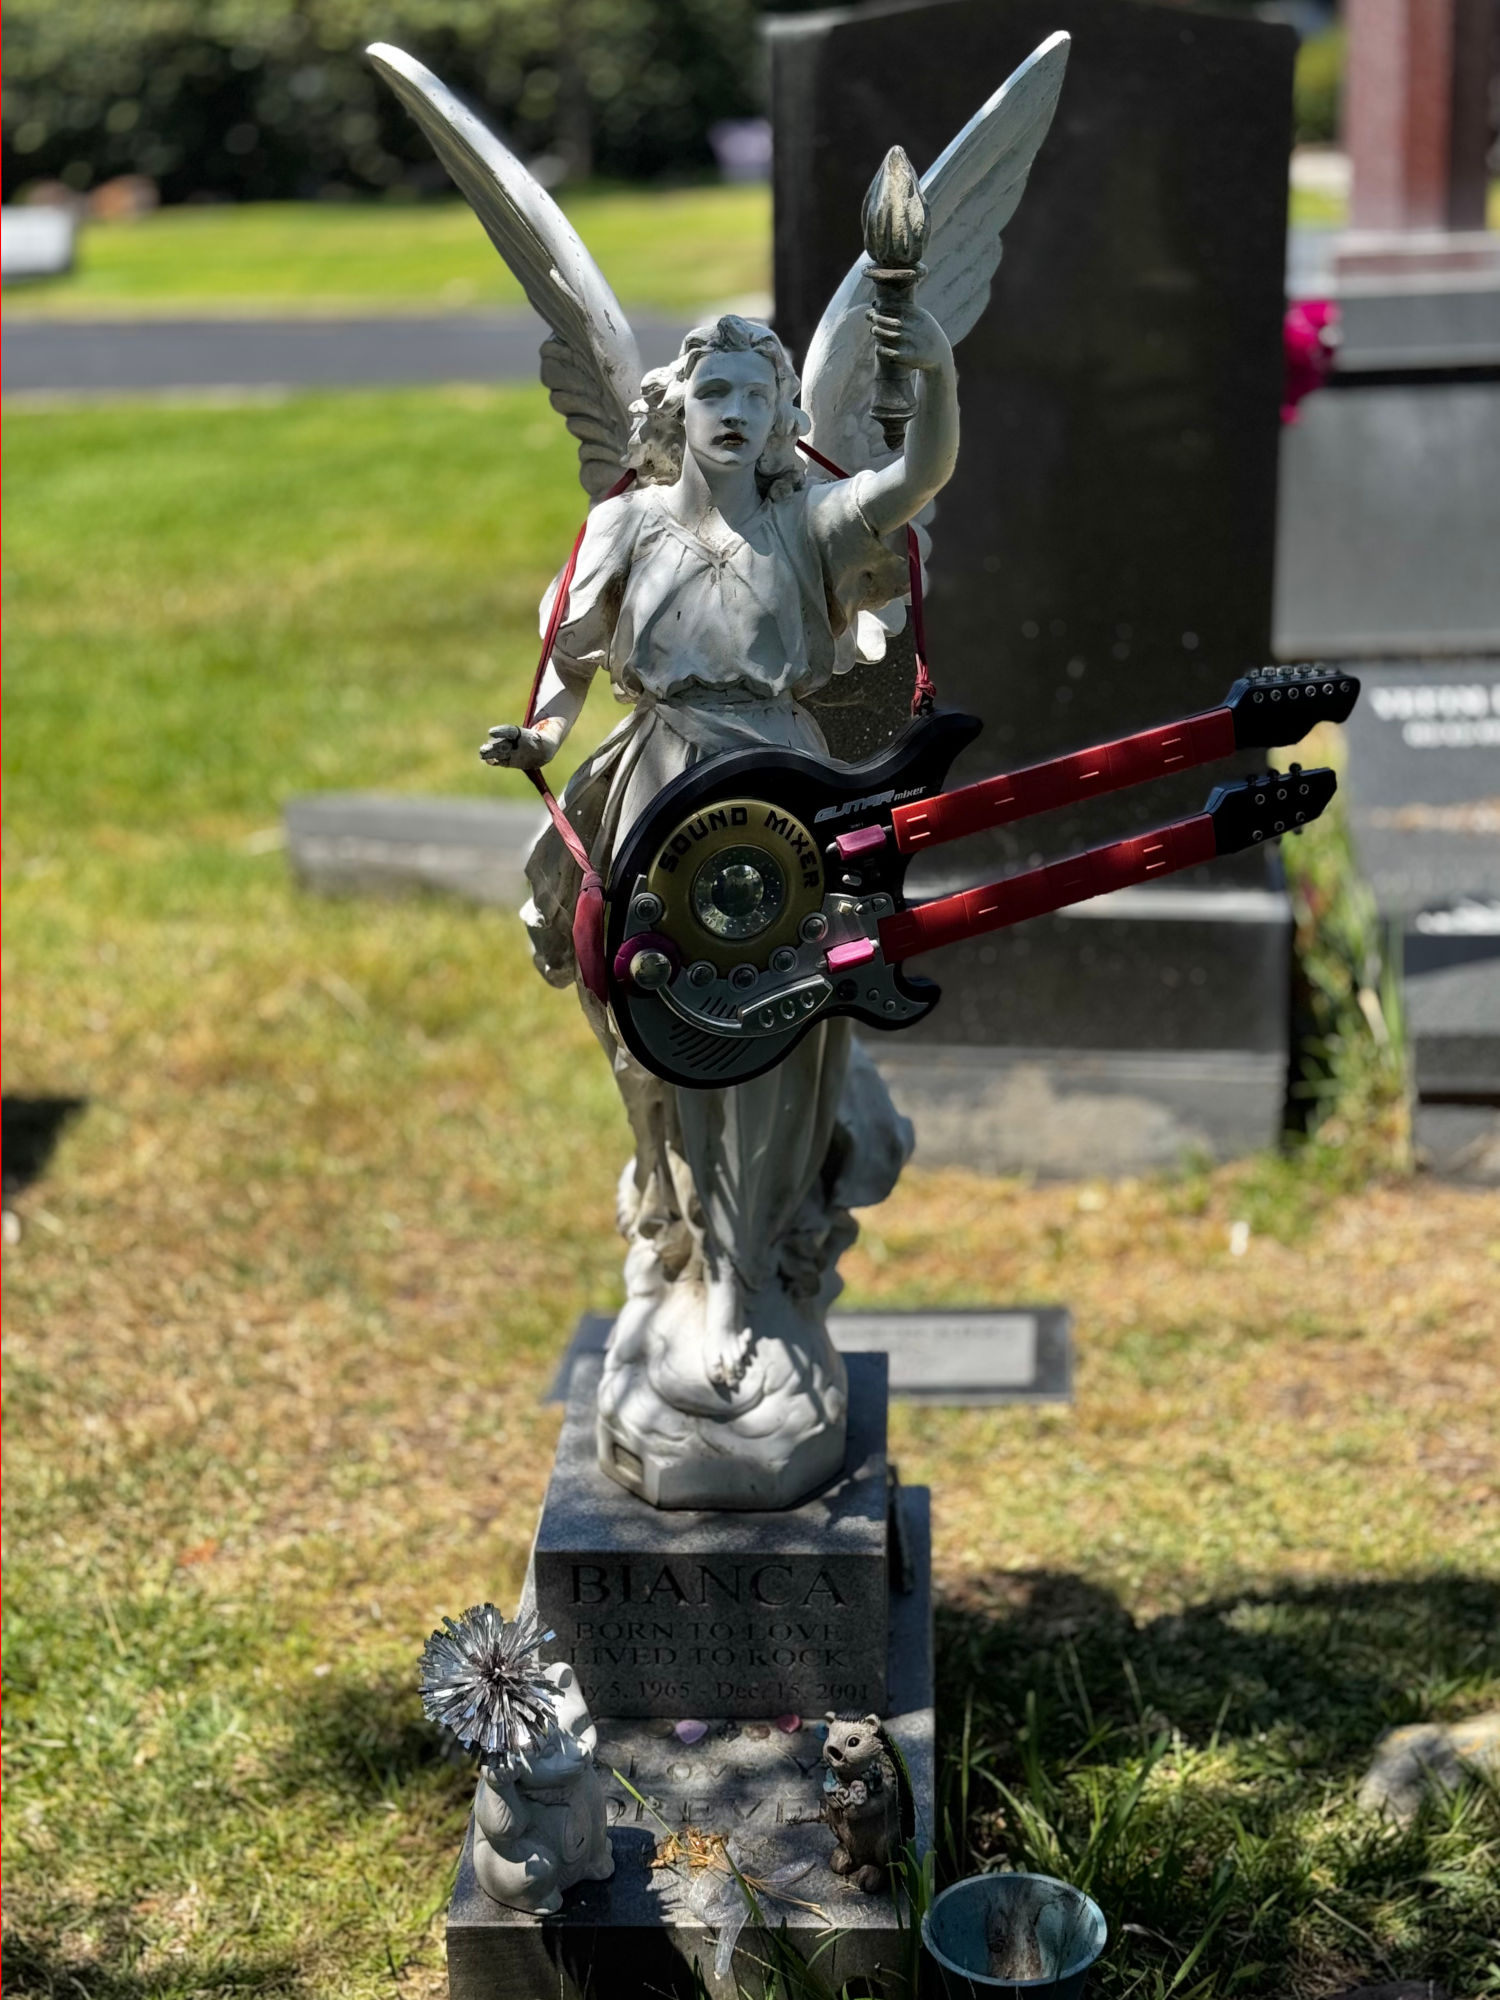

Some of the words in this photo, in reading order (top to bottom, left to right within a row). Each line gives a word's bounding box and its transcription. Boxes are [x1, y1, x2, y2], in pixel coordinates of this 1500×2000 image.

[893, 786, 927, 801] mixer
[658, 807, 748, 873] SOUND
[764, 810, 819, 888] MIXER
[568, 1565, 847, 1607] BIANCA
[576, 1621, 674, 1641] BORN
[686, 1621, 735, 1641] TO
[746, 1621, 843, 1641] LOVE
[570, 1647, 677, 1667] LIVED
[692, 1647, 735, 1667] TO
[748, 1647, 846, 1667] ROCK
[639, 1680, 690, 1699] 1965
[815, 1682, 868, 1700] 2001
